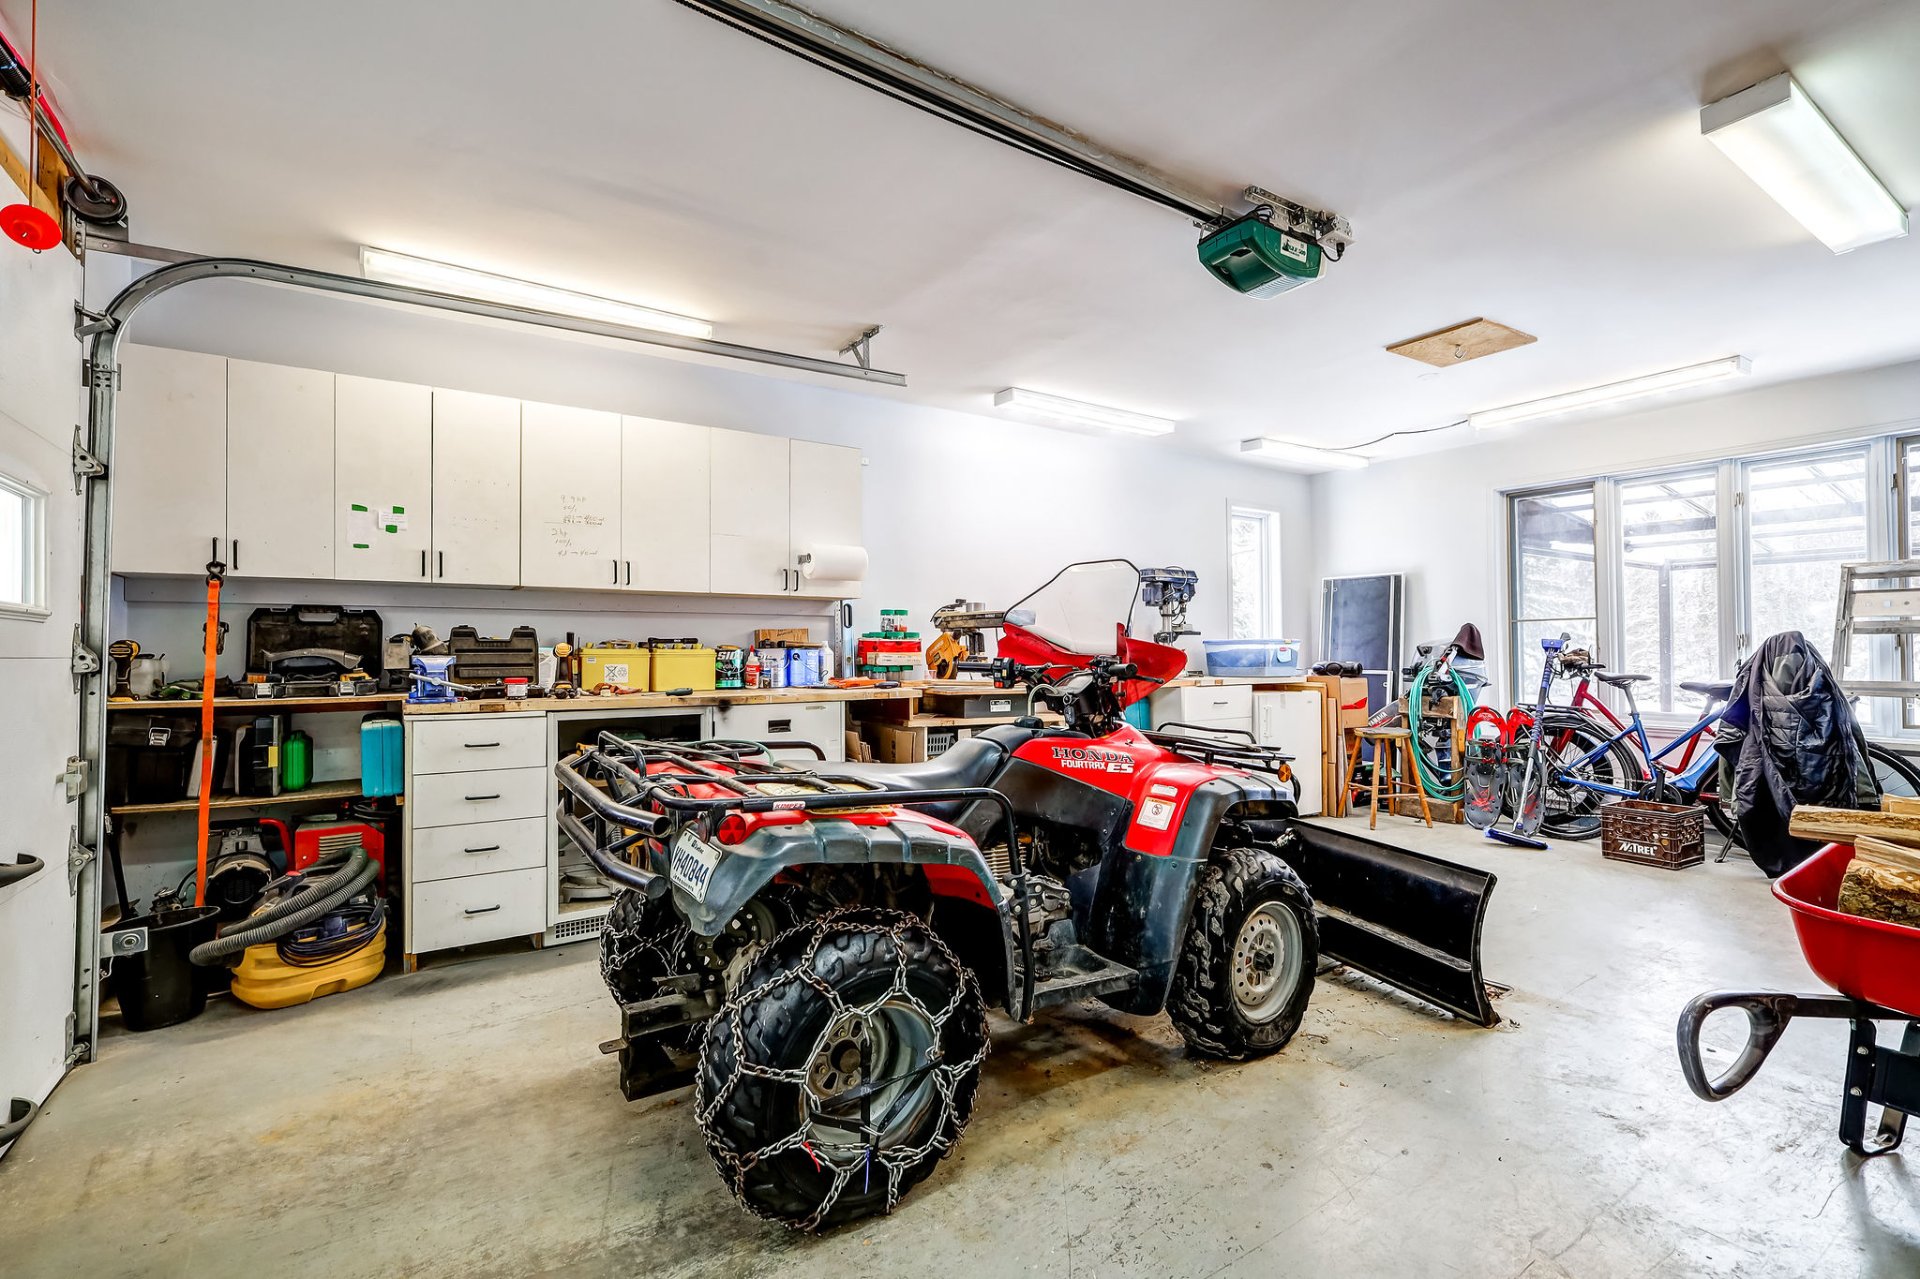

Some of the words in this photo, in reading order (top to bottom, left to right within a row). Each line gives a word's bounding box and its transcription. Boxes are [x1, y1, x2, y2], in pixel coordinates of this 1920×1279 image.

[1052, 747, 1135, 763] HONDA
[1061, 759, 1106, 770] FOURTRAX
[1106, 762, 1134, 773] ES
[1618, 841, 1656, 856] NATREL
